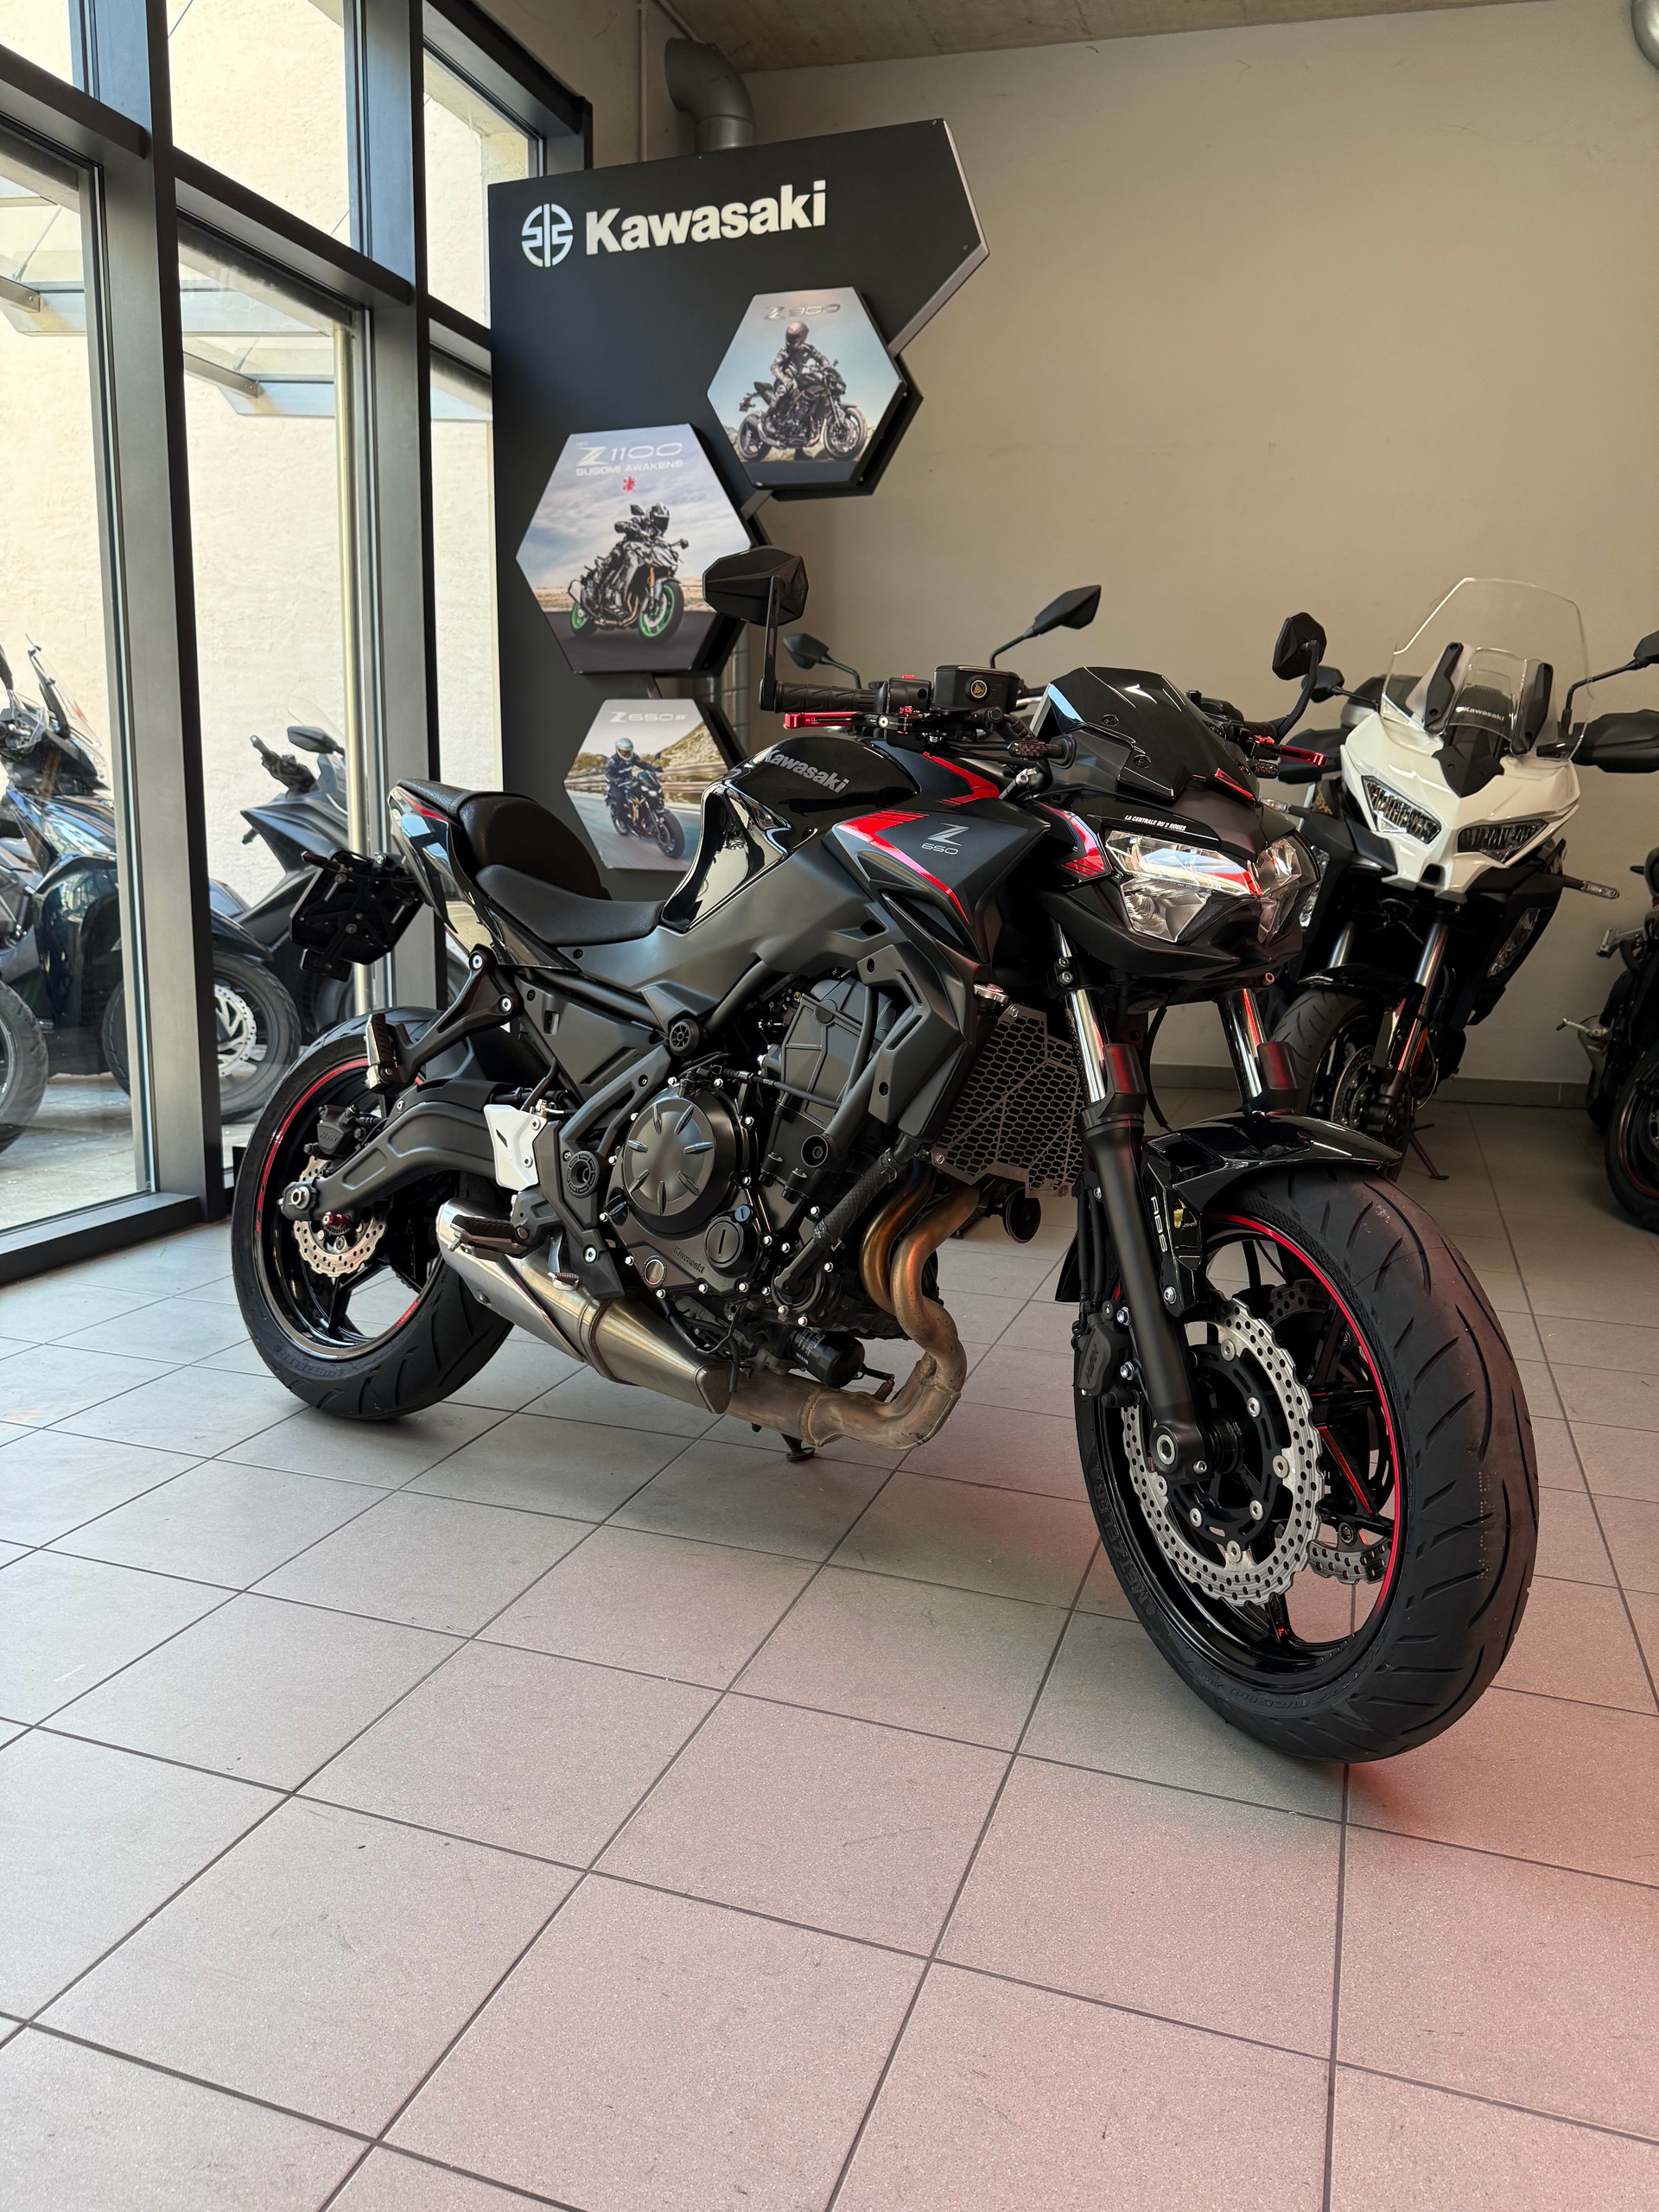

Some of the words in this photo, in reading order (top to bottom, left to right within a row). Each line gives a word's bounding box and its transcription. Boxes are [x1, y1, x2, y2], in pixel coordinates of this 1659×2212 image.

[586, 180, 826, 255] Kawasaki
[575, 465, 622, 477] SUGOMI
[625, 459, 683, 473] AWAKENS
[1464, 706, 1505, 722] Kawasaki
[764, 749, 850, 793] Kawasaki
[1132, 816, 1158, 826] CENTRALE
[921, 842, 959, 855] 650
[1150, 1196, 1168, 1253] ABS
[1092, 1483, 1149, 1605] METZELER
